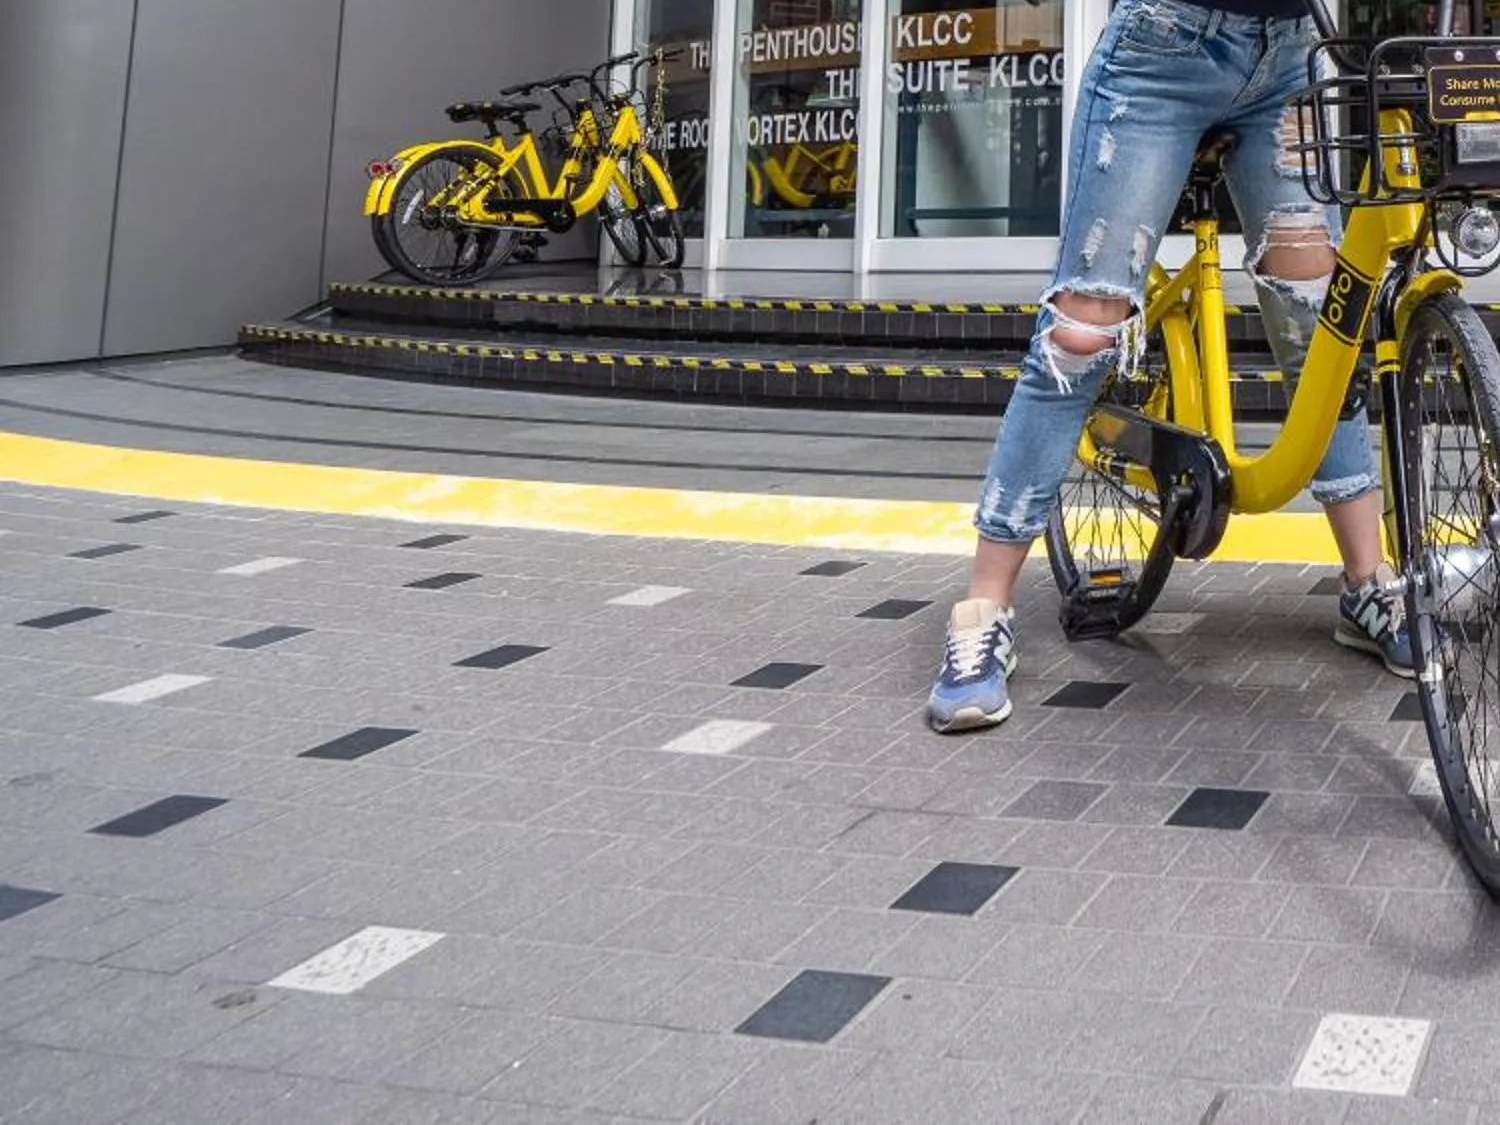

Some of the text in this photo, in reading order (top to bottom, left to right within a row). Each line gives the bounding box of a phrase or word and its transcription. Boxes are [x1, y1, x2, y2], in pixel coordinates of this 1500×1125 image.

[690, 41, 712, 70] TH
[896, 12, 973, 48] KLCC
[825, 68, 861, 101] TH
[887, 58, 971, 94] SUITE
[1445, 78, 1480, 90] Share
[1439, 94, 1496, 106] Consume
[680, 118, 710, 148] ROO
